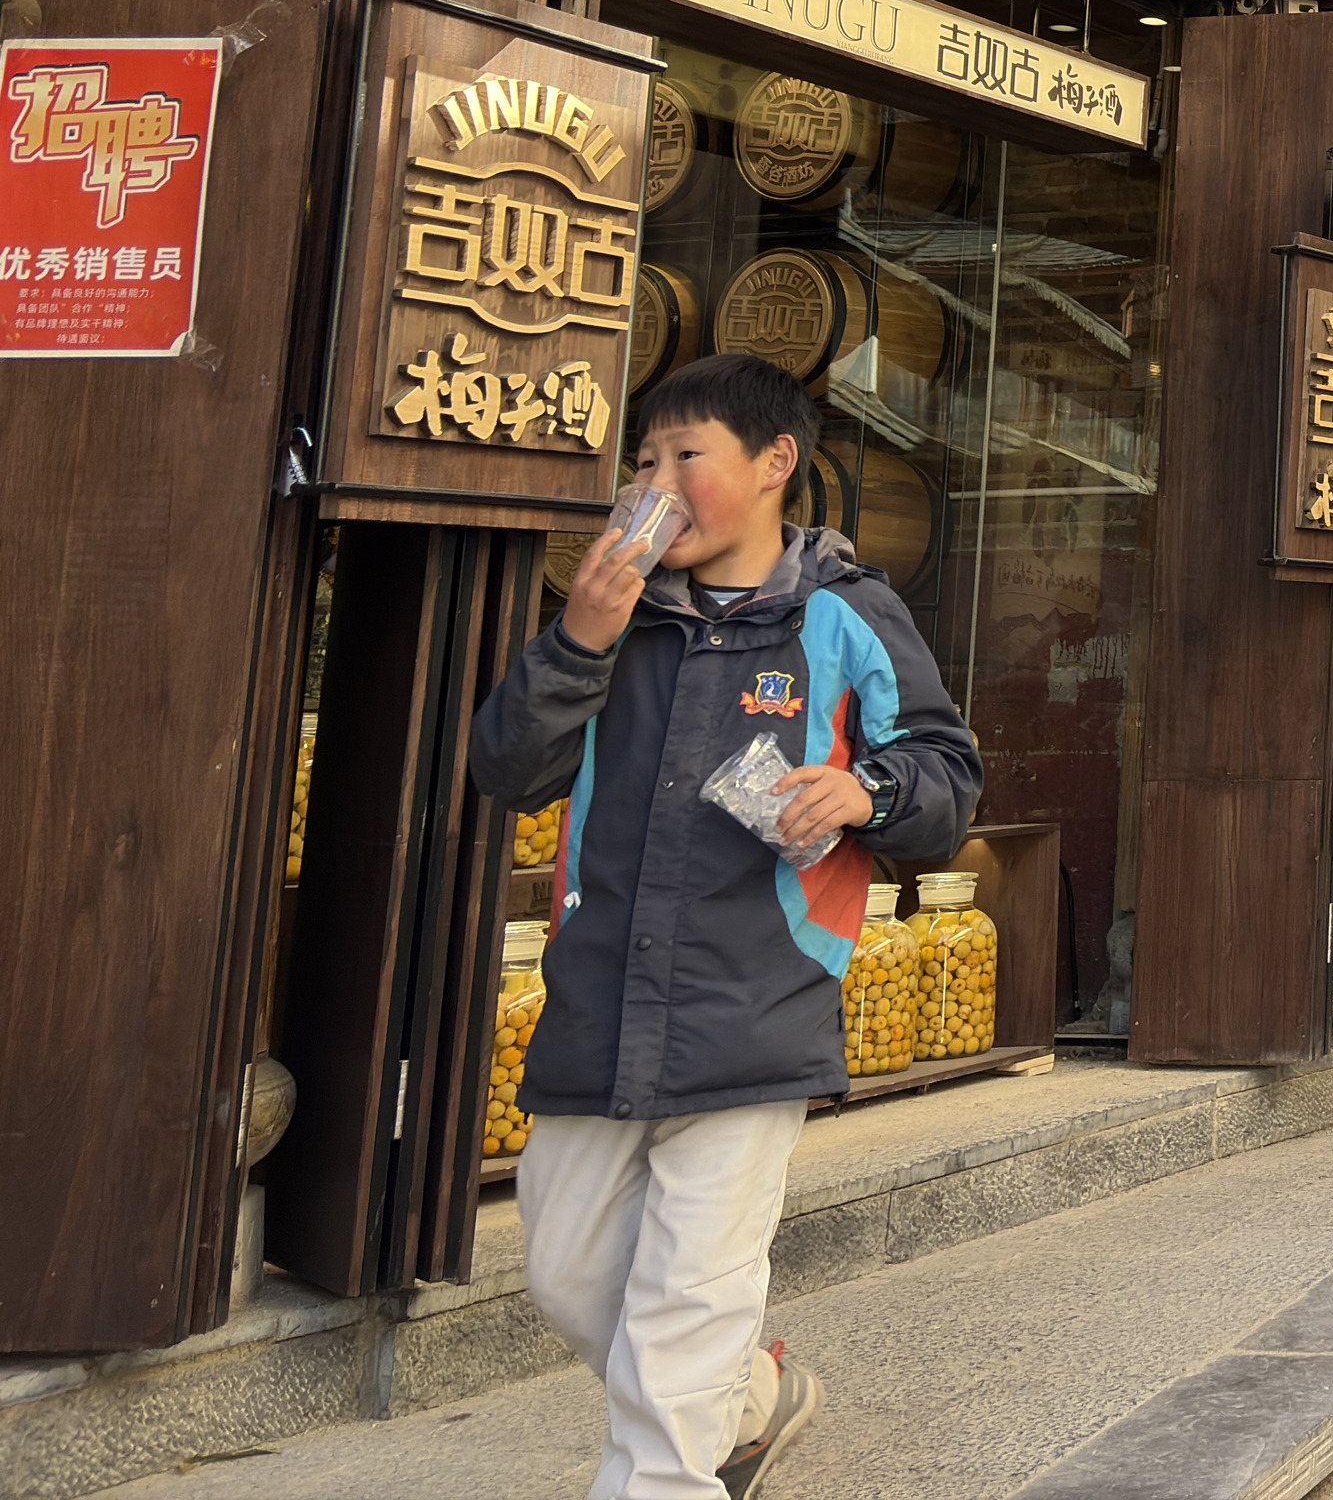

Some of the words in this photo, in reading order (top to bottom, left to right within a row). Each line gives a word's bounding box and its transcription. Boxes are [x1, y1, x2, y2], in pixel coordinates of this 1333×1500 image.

[765, 77, 837, 108] JINUGU
[1048, 64, 1123, 126] 梅子酒
[9, 65, 198, 229] 招聘
[428, 72, 627, 183] JINUGU
[0, 247, 182, 280] 优秀销售员
[746, 267, 816, 297] JINUGU
[386, 333, 612, 449] 梅子酒
